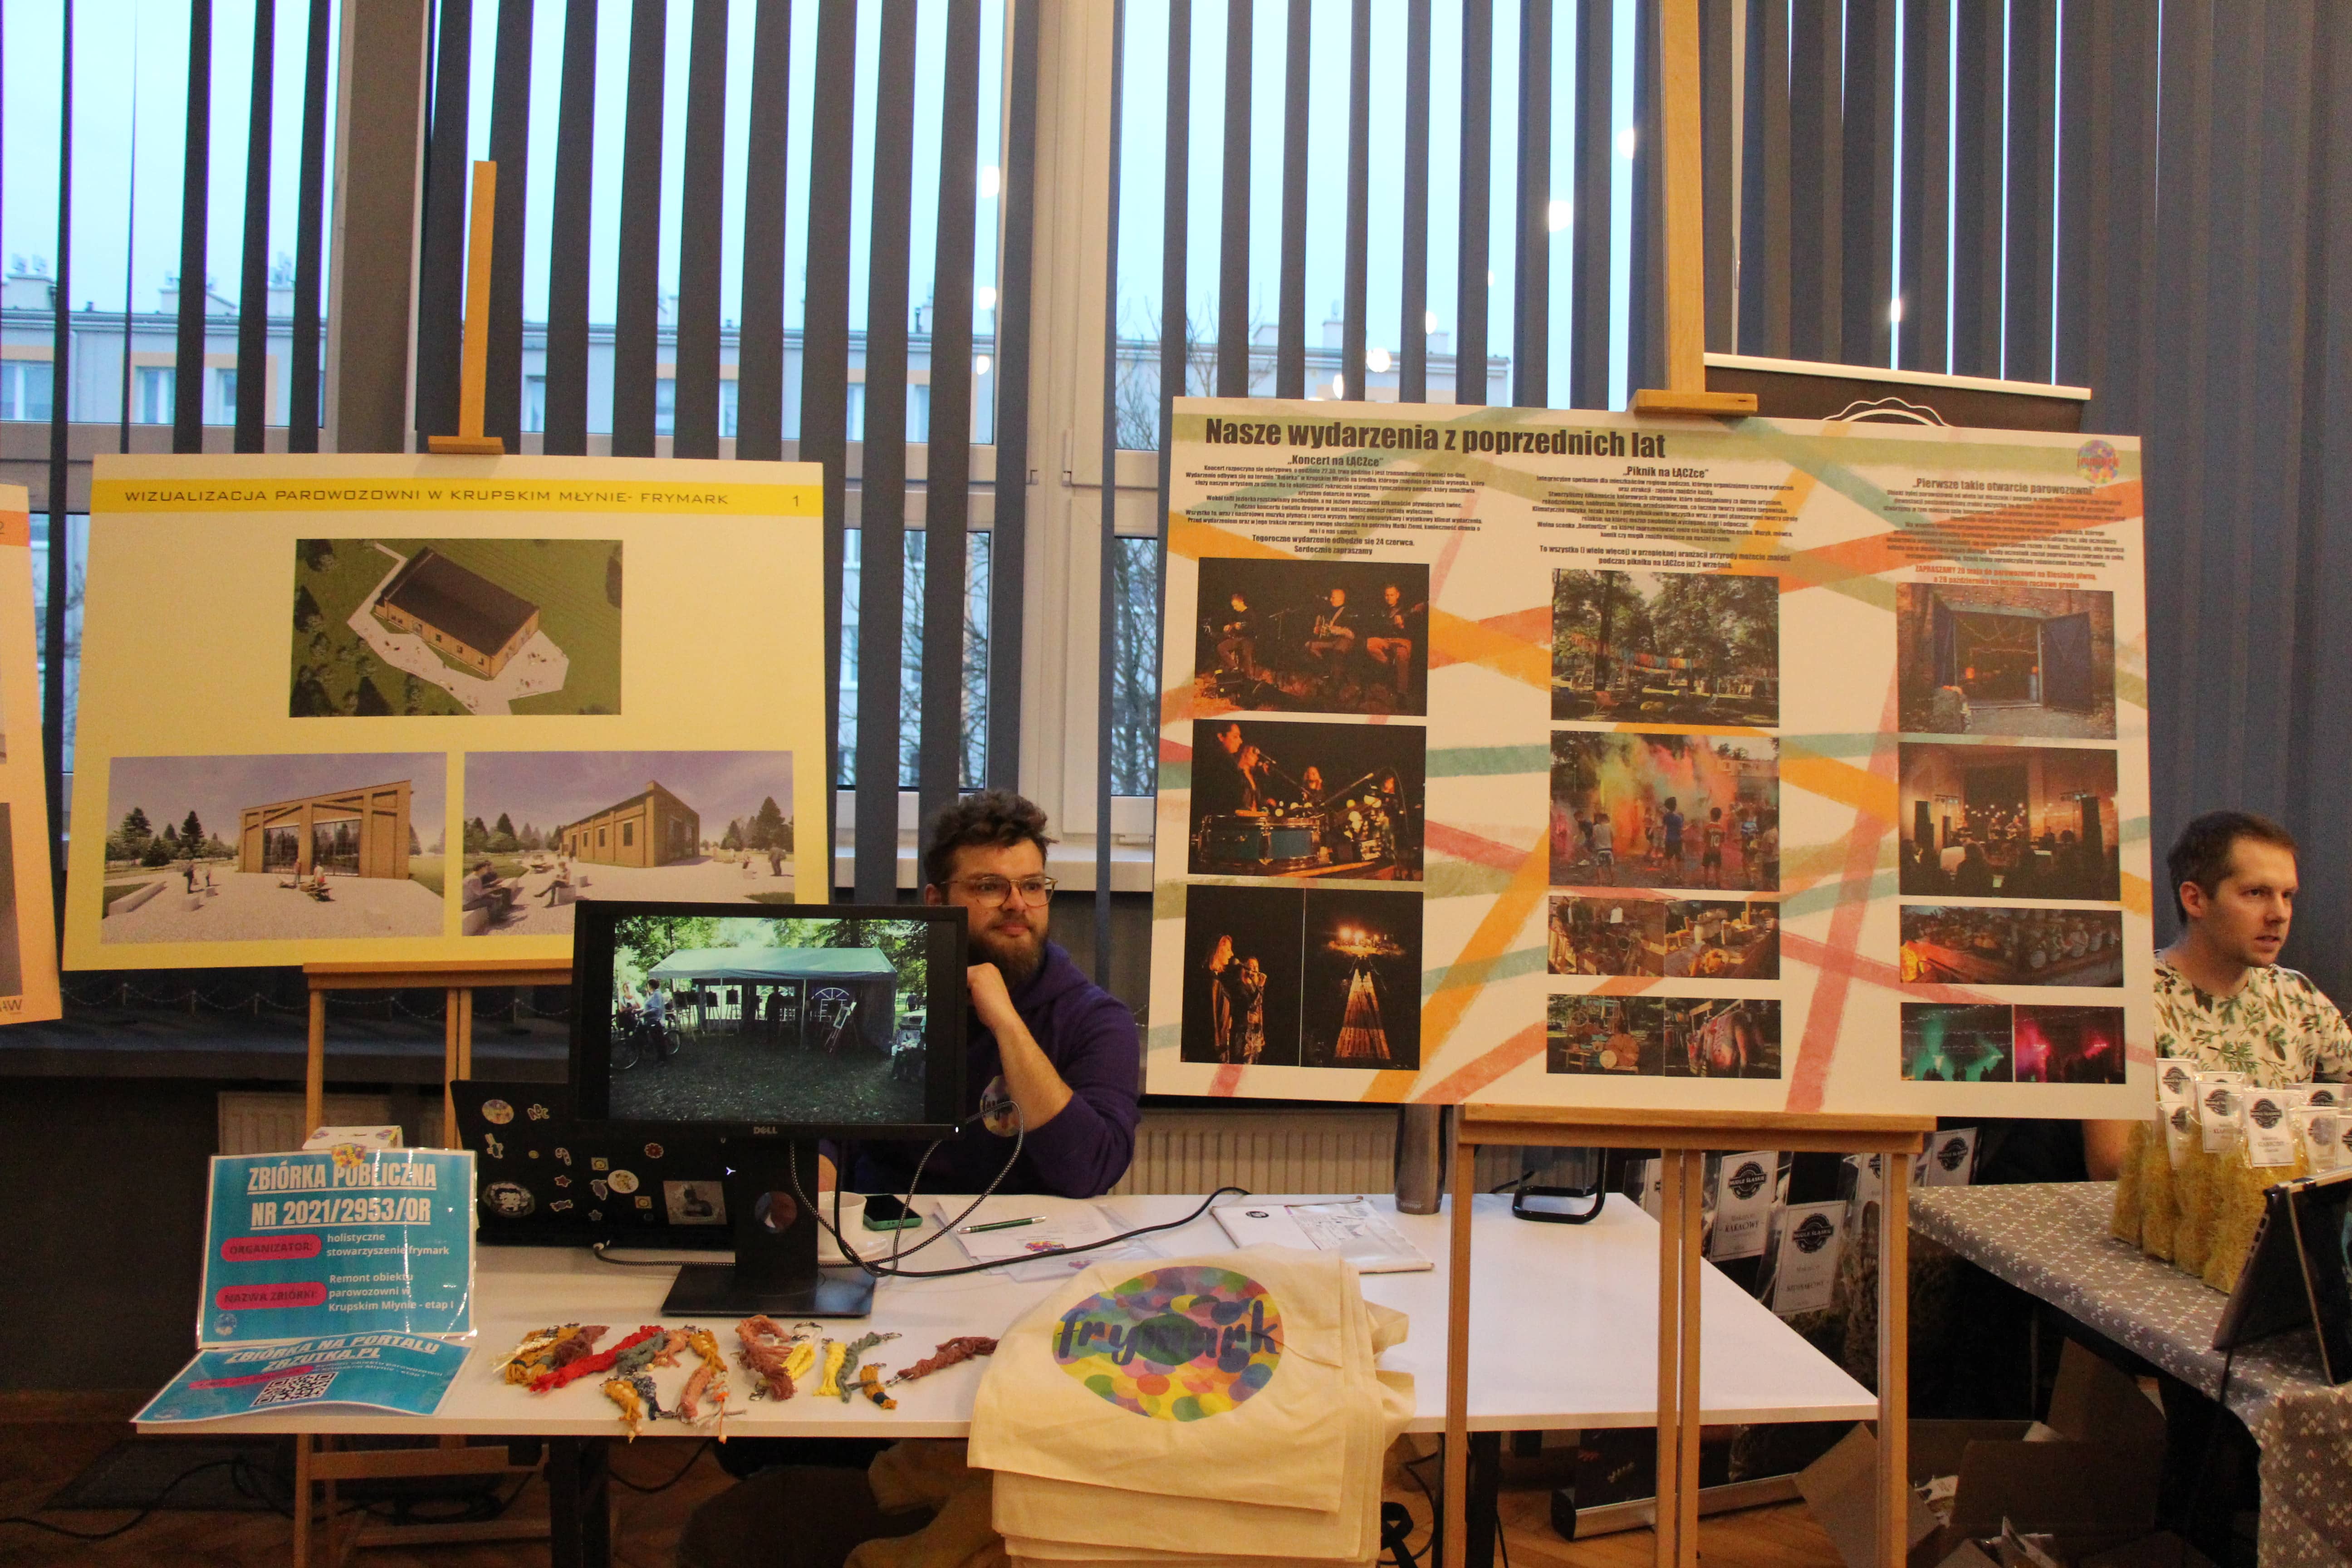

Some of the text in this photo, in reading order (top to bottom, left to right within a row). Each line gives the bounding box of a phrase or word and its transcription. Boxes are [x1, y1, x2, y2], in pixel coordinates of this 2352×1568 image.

[1205, 418, 1666, 459] Nasze wydarzenia z poprzednich lat
[1288, 455, 1329, 466] „Koncert
[1346, 457, 1383, 467] ŁĄCZce”
[1623, 466, 1655, 477] „Piknik
[1672, 468, 1708, 479] ŁĄCZce”
[1960, 480, 1984, 490] takie
[1987, 481, 2027, 491] otwarcie
[125, 490, 728, 505] WIZUALIZACJA PAROWOZOWNI W KRUPSKIM MŁYNIE- FRYMARK
[793, 495, 799, 508] 1
[1252, 534, 1290, 544] Tegoroczne
[1292, 535, 1330, 545] wydarzenie
[1332, 536, 1362, 546] odbędzie
[1364, 537, 1374, 546] się
[1294, 545, 1372, 556] Serdecznie zapraszamy
[1549, 545, 1578, 555] wszystko
[753, 1126, 778, 1134] DELL
[247, 1160, 436, 1191] ZBIÓRKA PUBLICZNA
[251, 1197, 431, 1226] NR 2021/2953/OR
[327, 1233, 386, 1243] holistyczne
[229, 1242, 313, 1254] ORGANIZATOR:
[326, 1245, 450, 1257] stowarzyszenie frymark
[329, 1272, 413, 1284] Remont obiektu
[224, 1293, 268, 1303] NAZWA
[329, 1287, 399, 1300] parowozowni
[328, 1301, 378, 1313] Krupskim
[382, 1300, 416, 1312] Młynie
[425, 1300, 448, 1311] etap
[1058, 1299, 1280, 1365] frymark
[230, 1334, 441, 1362] ZBIÓRKA NA PORTALU
[261, 1347, 381, 1373] ZRZUTKA.PL
